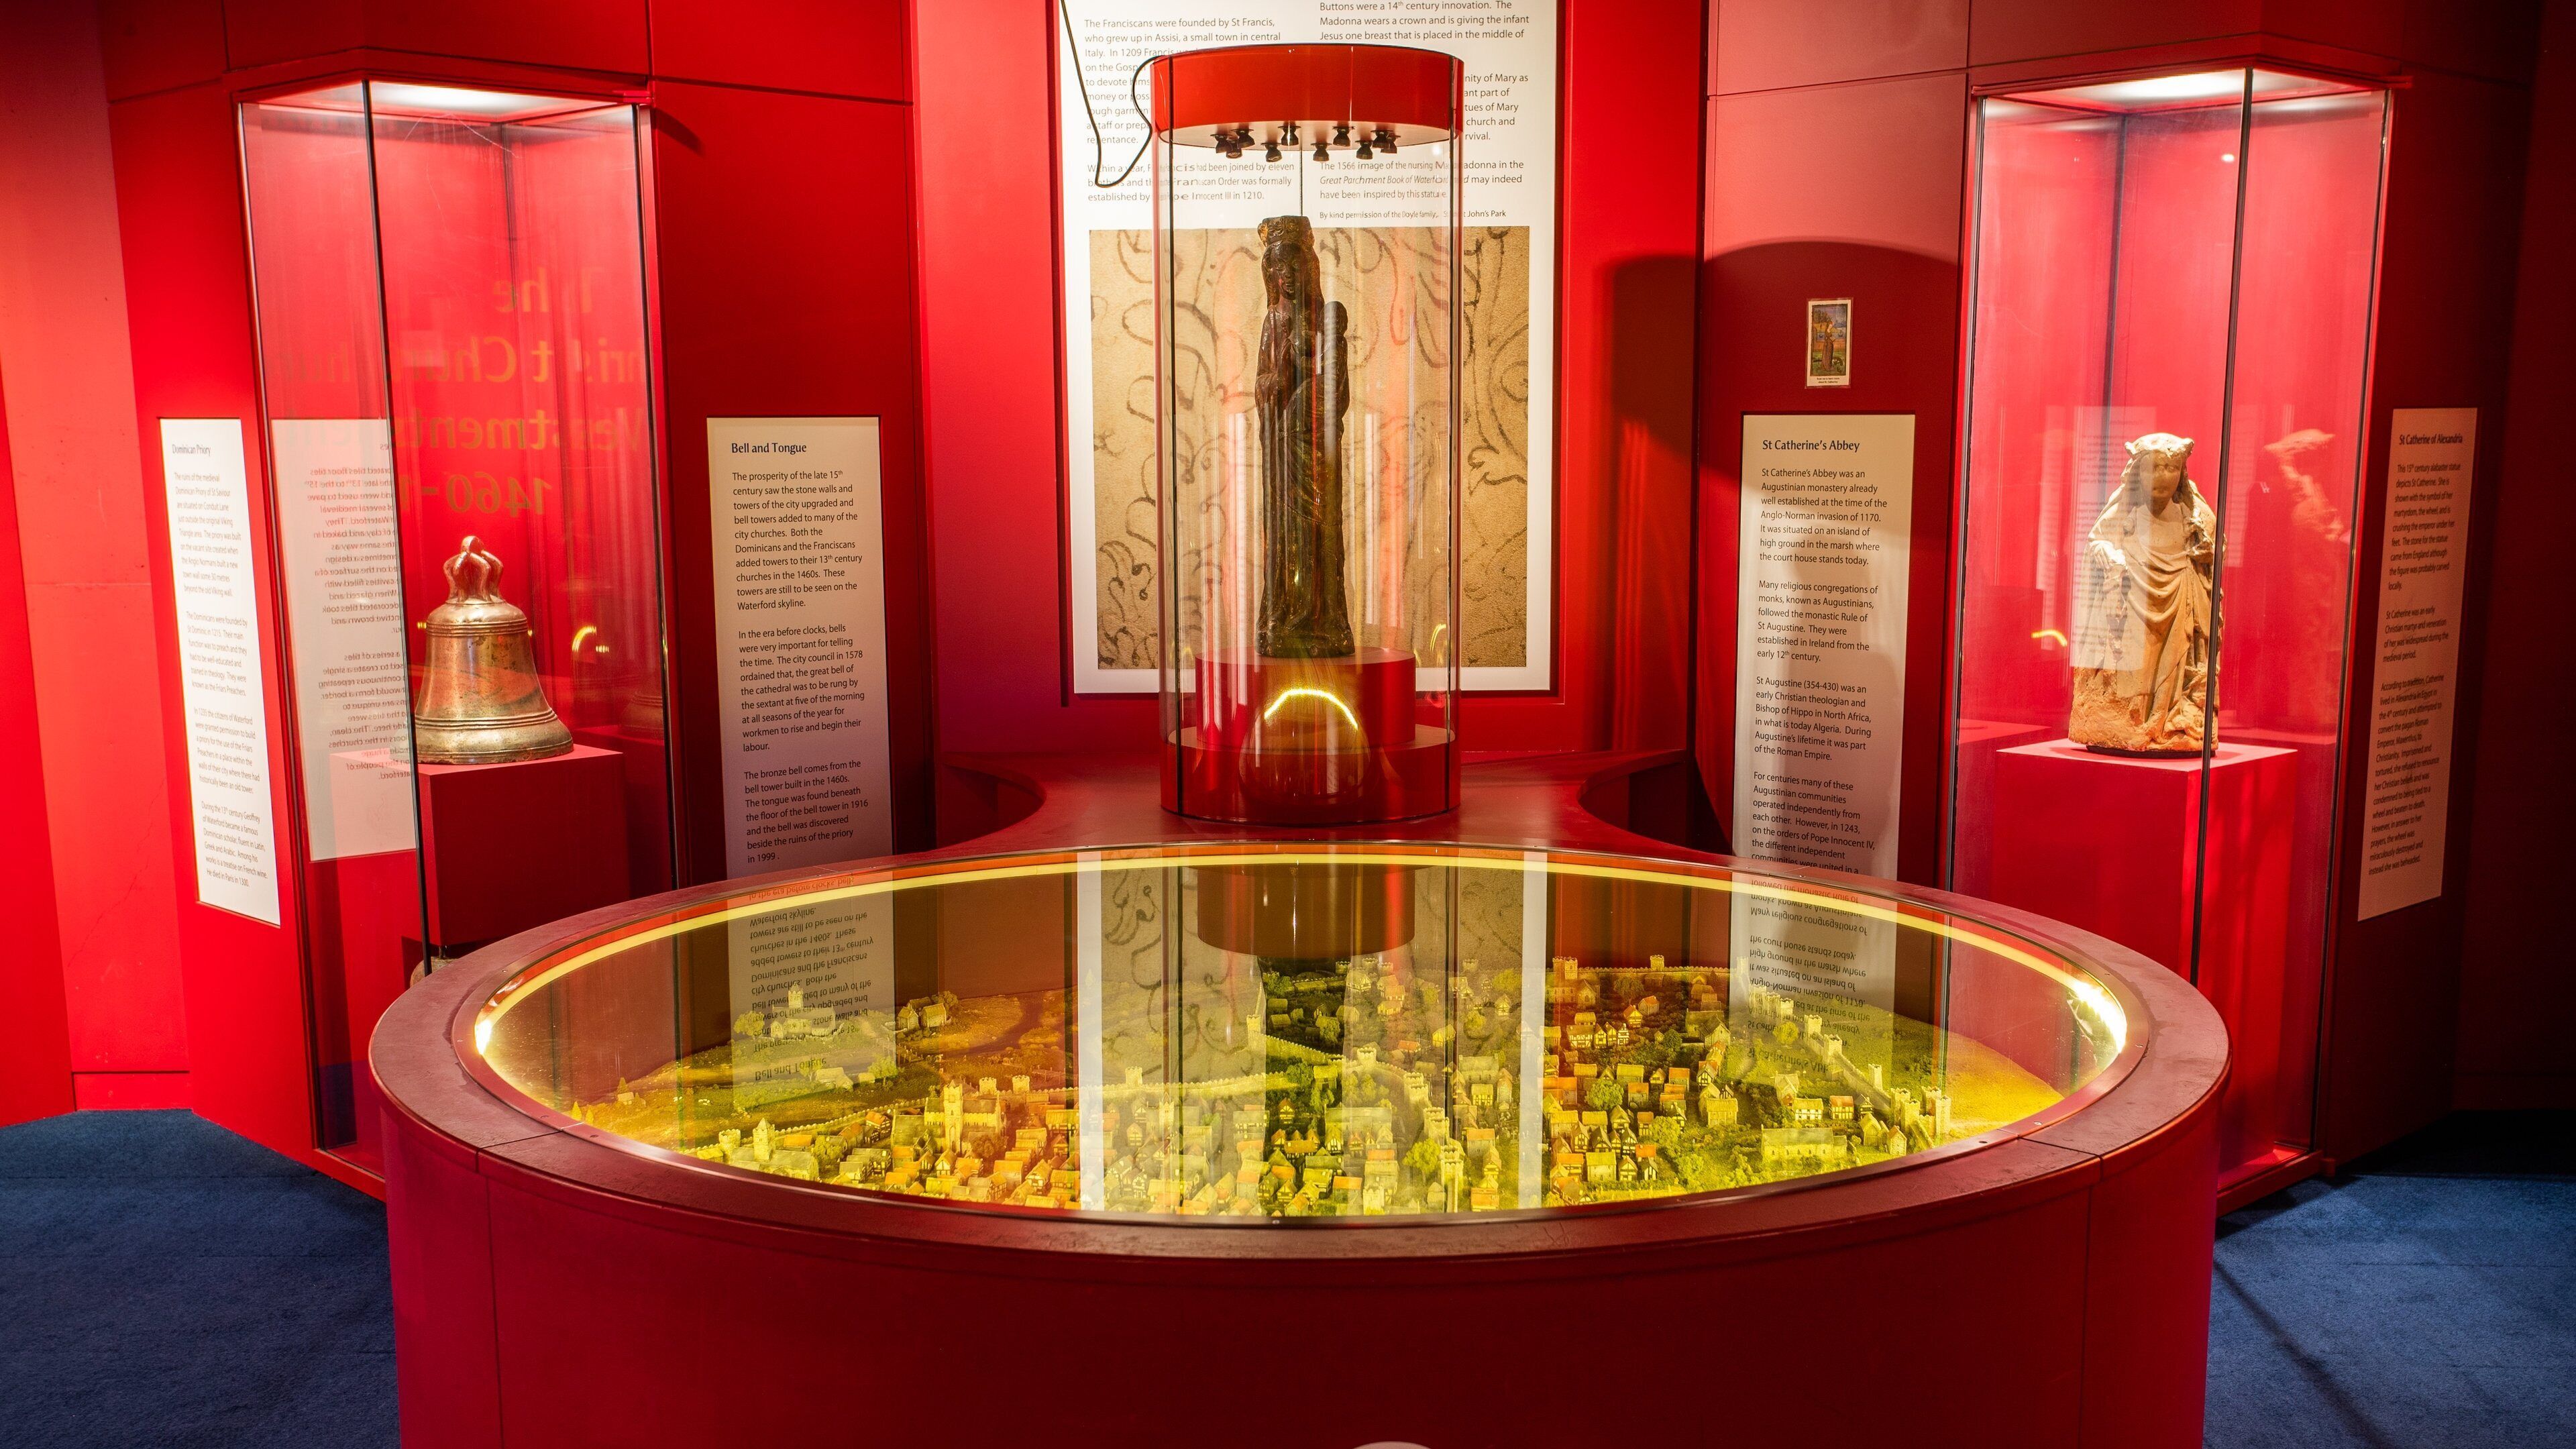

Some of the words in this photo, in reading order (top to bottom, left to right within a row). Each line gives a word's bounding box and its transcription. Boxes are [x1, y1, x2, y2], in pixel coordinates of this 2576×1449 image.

[1320, 2, 1354, 11] Buttons
[1405, 2, 1440, 11] century
[1442, 1, 1491, 9] innovation.
[1495, 0, 1512, 9] The
[1084, 19, 1101, 28] The
[1102, 19, 1153, 28] Franciscans
[1178, 17, 1216, 27] founded
[1218, 17, 1230, 29] by
[1231, 17, 1240, 27] St
[1242, 17, 1275, 27] Francis,
[1320, 16, 1362, 25] Madonna
[1363, 17, 1390, 25] wears
[1428, 15, 1446, 25] and
[1448, 15, 1454, 24] is
[1456, 15, 1485, 26] giving
[1486, 14, 1501, 24] the
[1503, 14, 1529, 23] infant
[1084, 34, 1104, 42] who
[1106, 35, 1128, 44] grew
[1130, 35, 1142, 44] up
[1155, 33, 1181, 43] Assisi,
[1189, 32, 1213, 42] small
[1215, 34, 1238, 42] town
[1240, 32, 1248, 41] in
[1250, 32, 1281, 41] central
[1319, 32, 1343, 40] Jesus
[1364, 30, 1392, 40] breast
[1393, 30, 1412, 40] that
[1413, 30, 1421, 40] is
[1422, 30, 1452, 41] placed
[1454, 30, 1463, 38] in
[1464, 30, 1480, 39] the
[1481, 29, 1513, 38] middle
[1514, 28, 1525, 38] of
[1085, 48, 1105, 58] Italy.
[1121, 48, 1142, 56] 1209
[1483, 72, 1493, 83] of
[1494, 73, 1517, 85] Mary
[1465, 117, 1496, 126] church
[1498, 116, 1515, 125] and
[1217, 176, 1240, 186] Order
[1258, 176, 1292, 187] formally
[1470, 176, 1490, 185] may
[1491, 174, 1522, 183] indeed
[1087, 192, 1137, 201] established
[1139, 192, 1150, 203] by
[1232, 191, 1240, 199] in
[1242, 191, 1265, 200] 1210.
[1490, 209, 1507, 217] Park
[2399, 434, 2405, 445] St
[2406, 434, 2430, 445] Catherine
[2430, 434, 2436, 443] of
[2436, 433, 2463, 443] Alexandria
[172, 444, 196, 453] Dominican
[196, 444, 211, 456] Priory
[731, 442, 749, 453] Bell
[751, 442, 769, 453] and
[771, 442, 807, 455] Tongue
[1762, 439, 1772, 450] St
[1828, 439, 1860, 453] Abbey
[731, 472, 747, 481] The
[749, 471, 789, 483] prosperity
[790, 471, 798, 480] of
[800, 471, 812, 479] the
[814, 471, 828, 480] late
[1761, 468, 1769, 477] St
[1812, 468, 1837, 480] Abbey
[1838, 470, 1854, 478] was
[733, 487, 763, 497] century
[781, 485, 794, 494] the
[795, 486, 817, 494] stone
[818, 484, 837, 493] walls
[838, 484, 853, 493] and
[1761, 482, 1806, 493] Augustinian
[1807, 484, 1848, 494] monastery
[1849, 483, 1878, 495] already
[733, 502, 760, 510] towers
[761, 499, 770, 509] of
[771, 500, 784, 509] the
[785, 500, 800, 511] city
[801, 498, 838, 510] upgraded
[839, 497, 854, 507] and
[1760, 496, 1776, 505] well
[1776, 496, 1820, 506] established
[1821, 498, 1829, 506] at
[1830, 497, 1843, 506] the
[1844, 498, 1863, 507] time
[1864, 498, 1873, 507] of
[1874, 498, 1888, 508] the
[1760, 510, 1815, 521] Anglo-Norman
[1817, 512, 1848, 521] invasion
[1850, 512, 1860, 521] of
[1860, 513, 1881, 522] 1170.
[1755, 702, 1780, 716] Bishop
[1780, 705, 1790, 714] of
[1790, 706, 1814, 718] Hippo
[1815, 708, 1822, 717] in
[1823, 709, 1845, 720] North
[1847, 711, 1872, 723] Africa,
[743, 770, 759, 780] The
[760, 769, 788, 778] bronze
[788, 765, 802, 775] bell
[804, 764, 828, 773] comes
[829, 761, 847, 771] from
[848, 759, 861, 768] the
[1752, 800, 1786, 810] operated
[1786, 802, 1841, 818] independently
[1842, 808, 1860, 819] from
[747, 855, 755, 863] in
